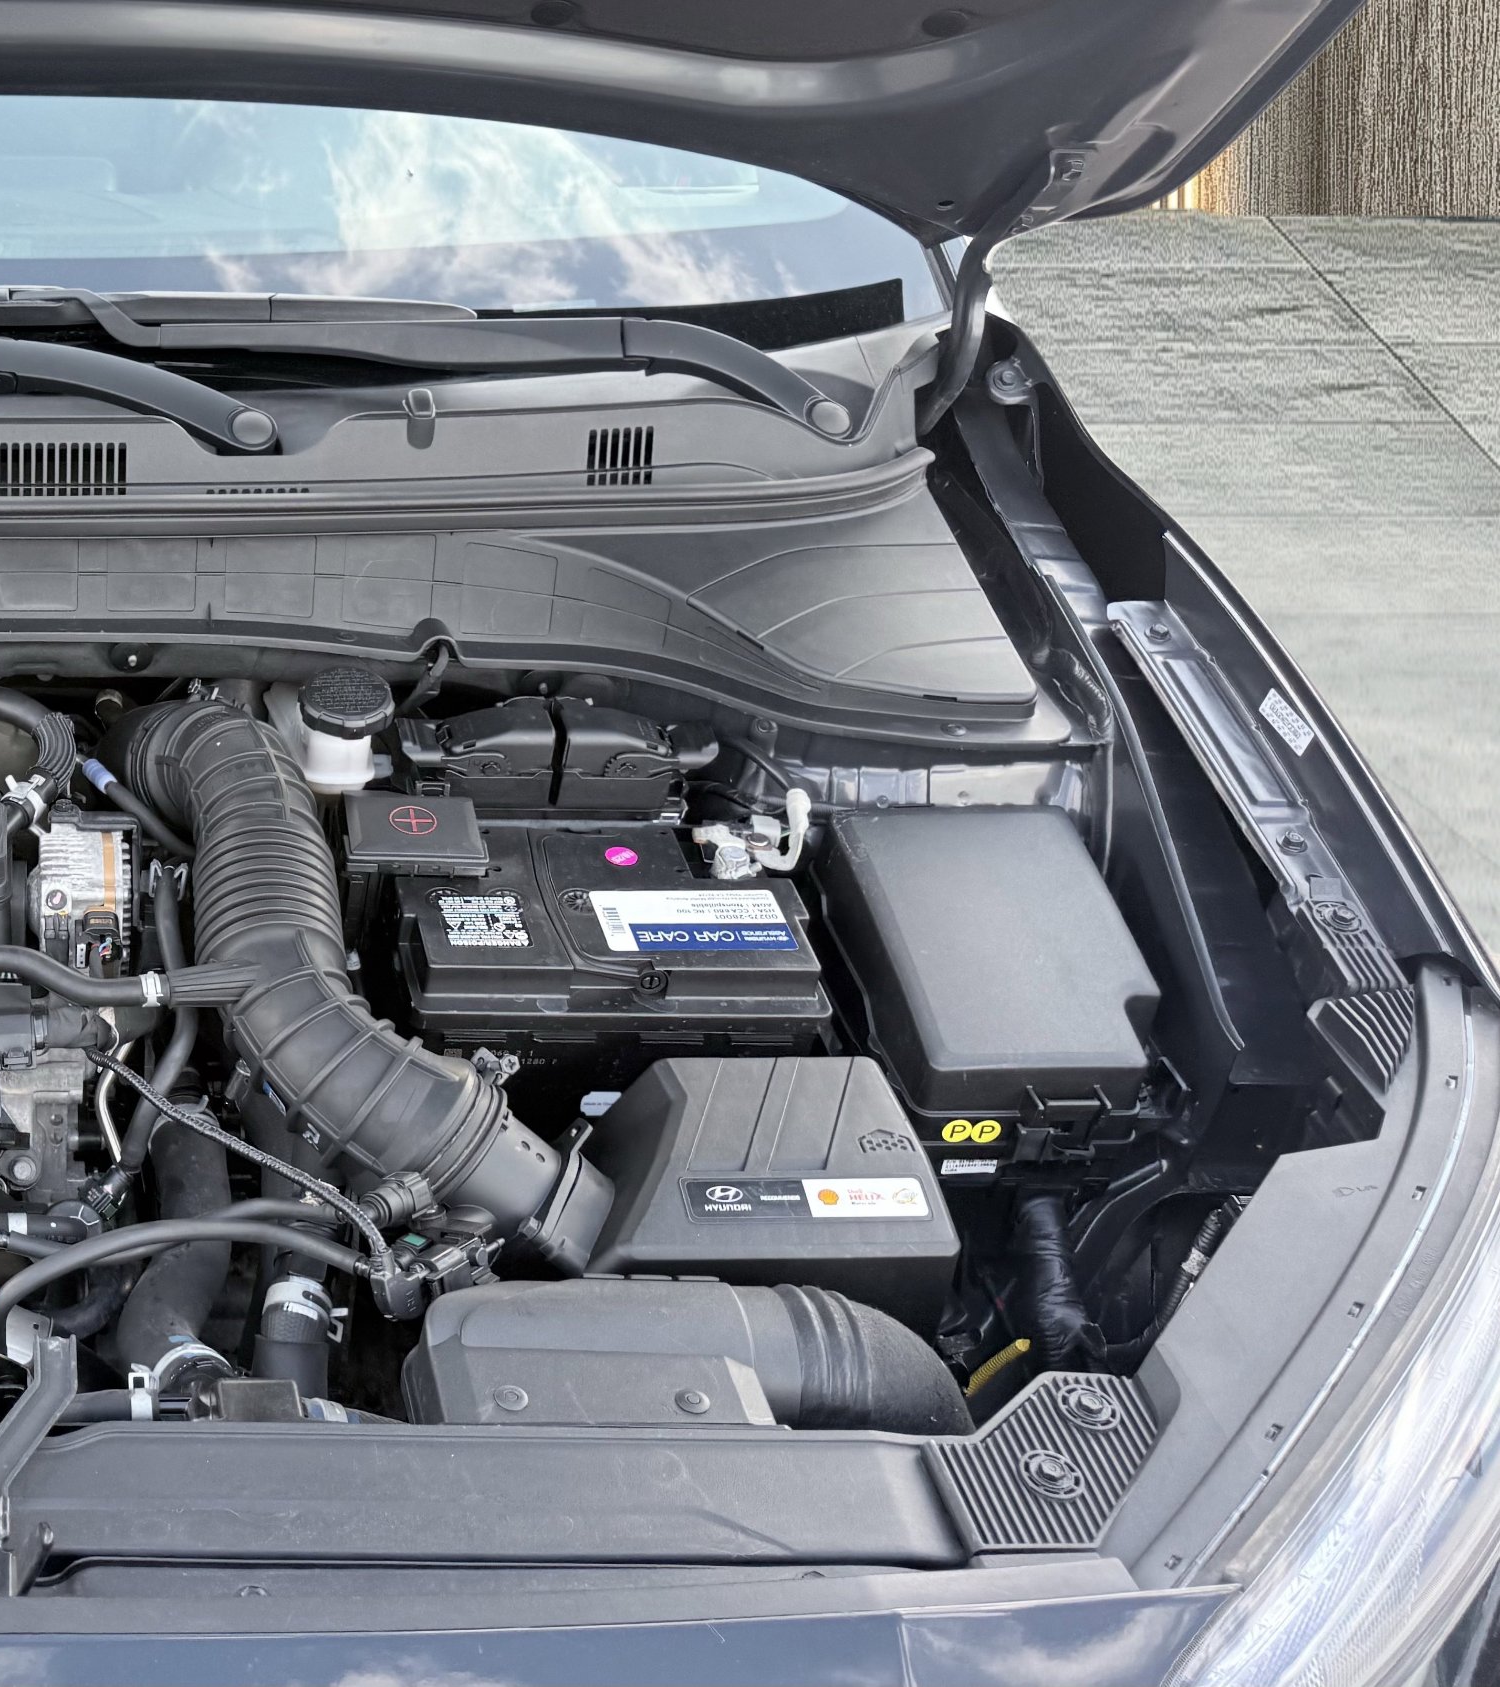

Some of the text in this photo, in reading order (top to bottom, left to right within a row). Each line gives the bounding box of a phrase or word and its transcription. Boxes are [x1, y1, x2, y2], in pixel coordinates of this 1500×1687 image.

[636, 930, 735, 942] CAR CARE
[949, 1124, 996, 1139] P P
[704, 1203, 752, 1212] HYUNDAI
